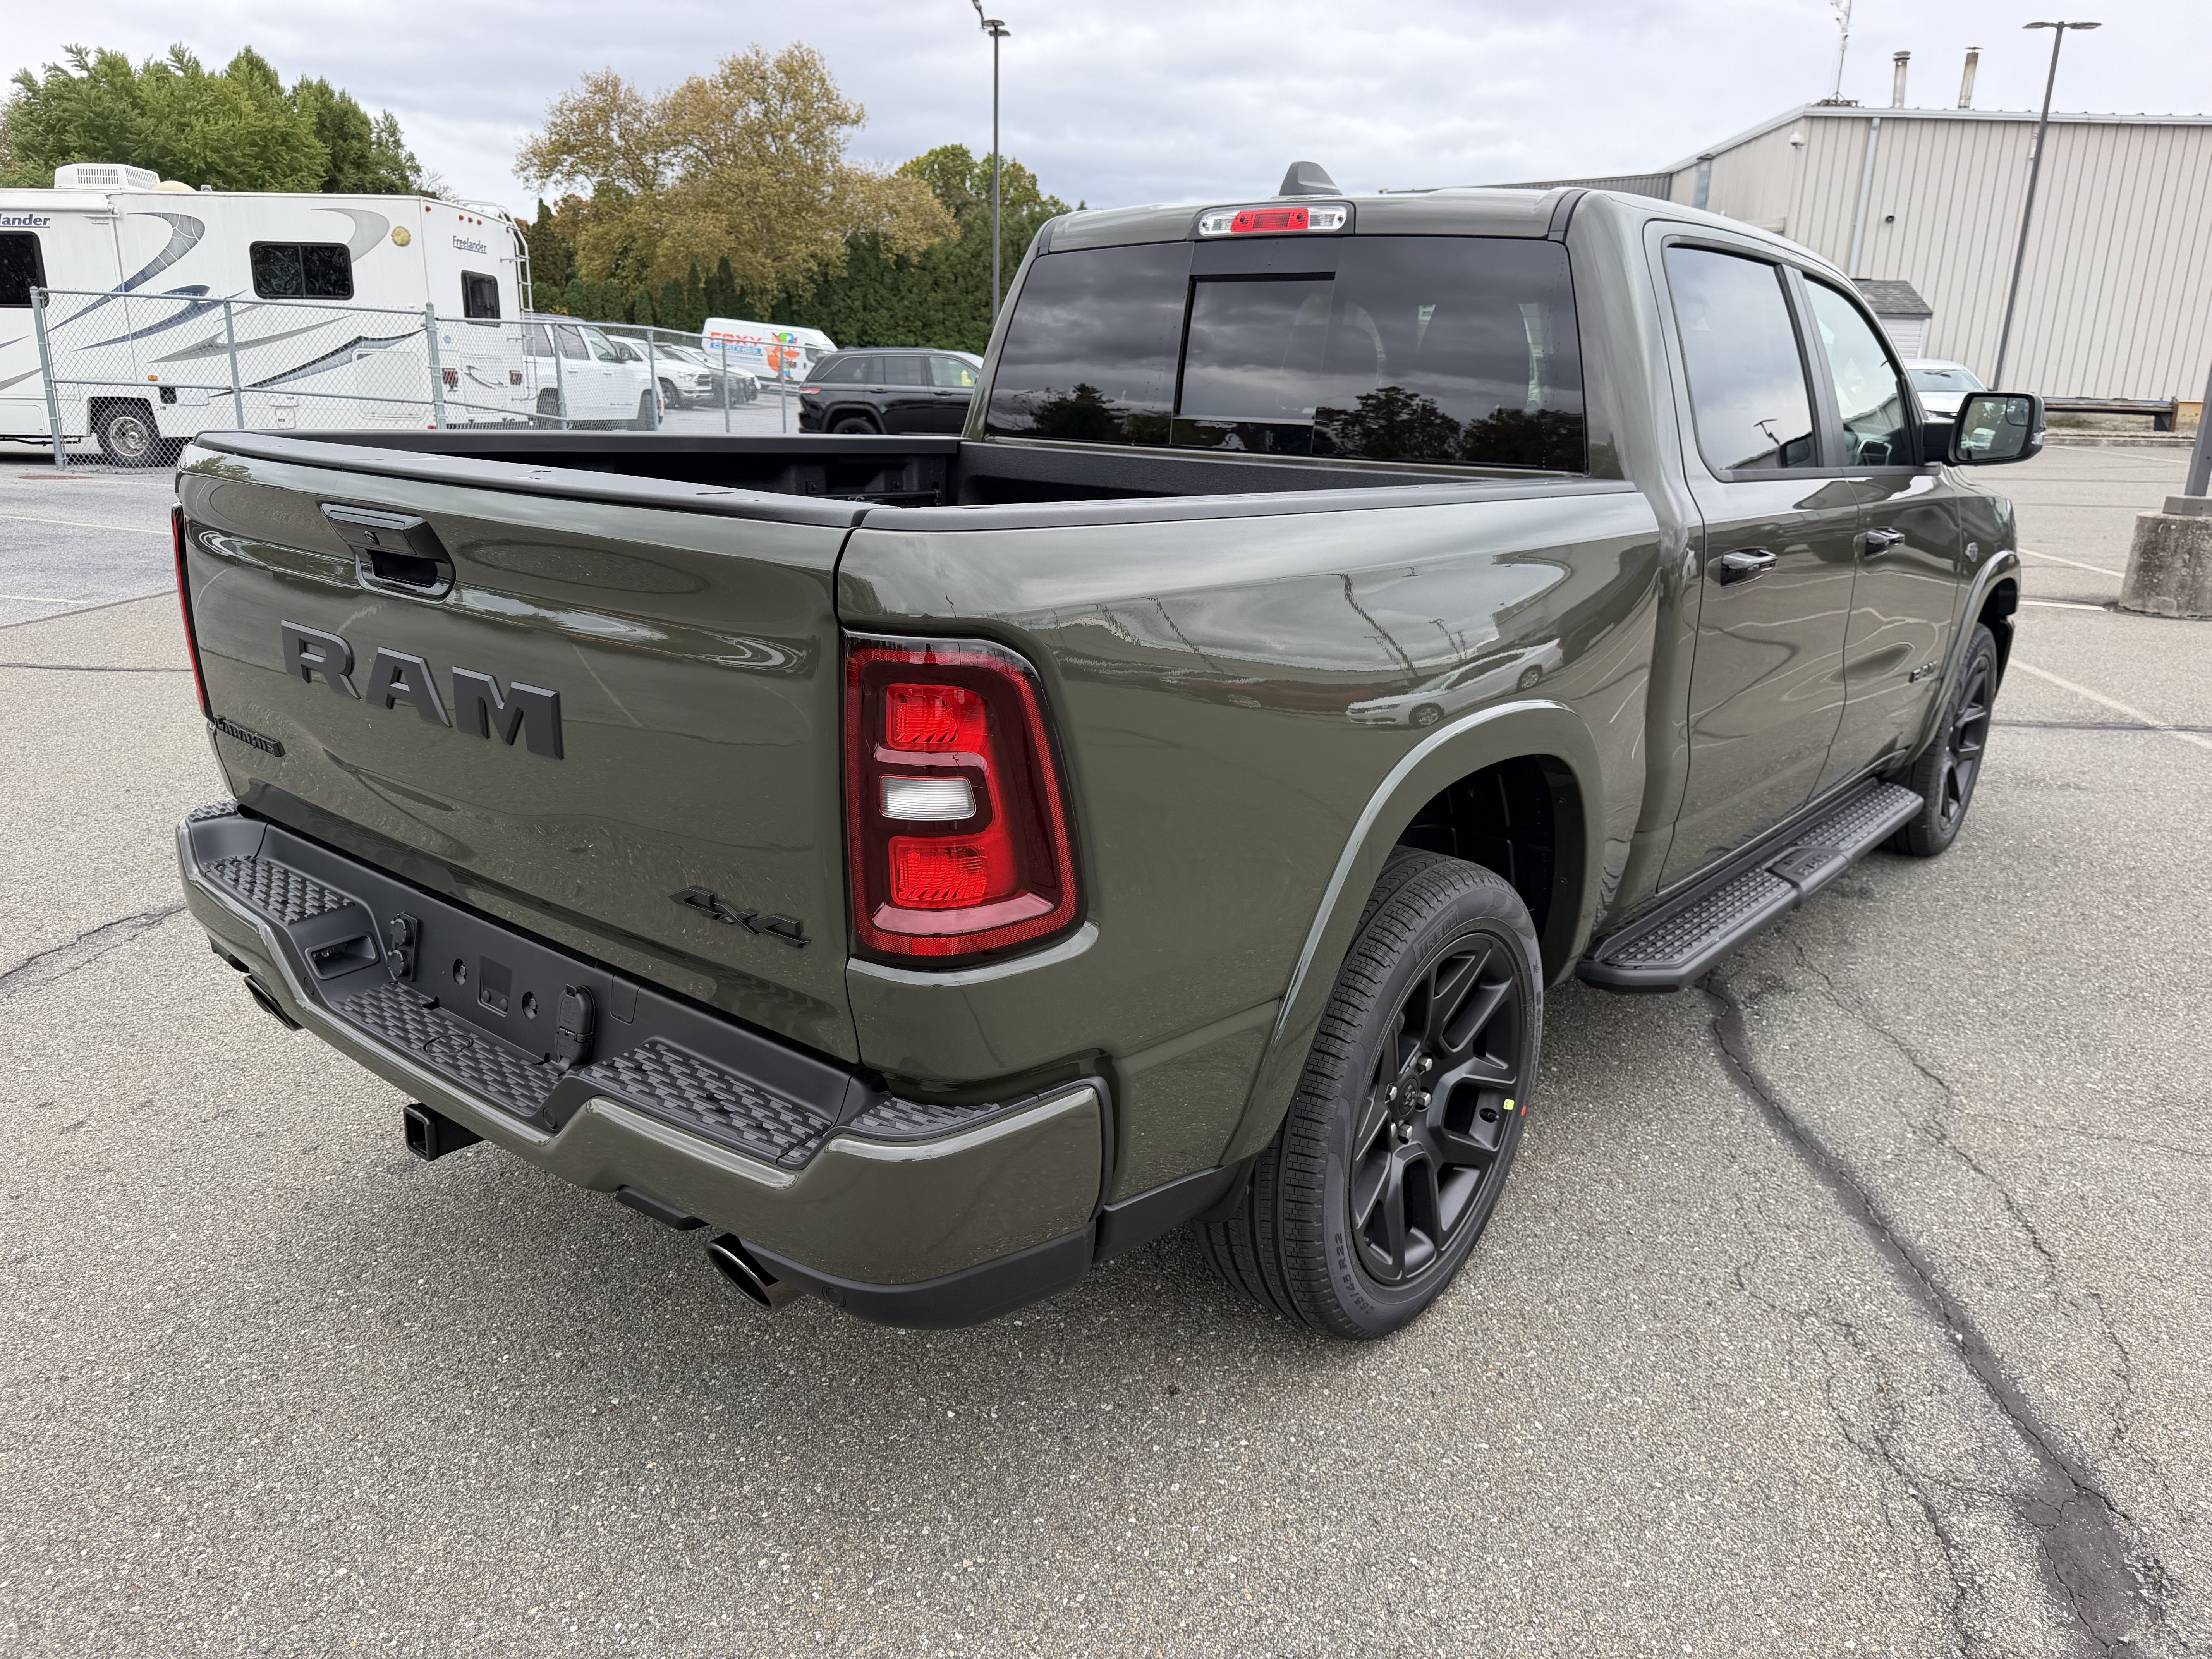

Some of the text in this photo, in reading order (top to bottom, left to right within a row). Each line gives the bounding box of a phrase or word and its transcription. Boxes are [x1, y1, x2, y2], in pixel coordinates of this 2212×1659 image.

[453, 235, 487, 253] Freelander
[710, 332, 762, 347] FOXY
[281, 620, 564, 760] RAM
[214, 714, 286, 757] LARAMIE
[668, 885, 811, 948] 4x4
[1335, 1232, 1347, 1270] R22
